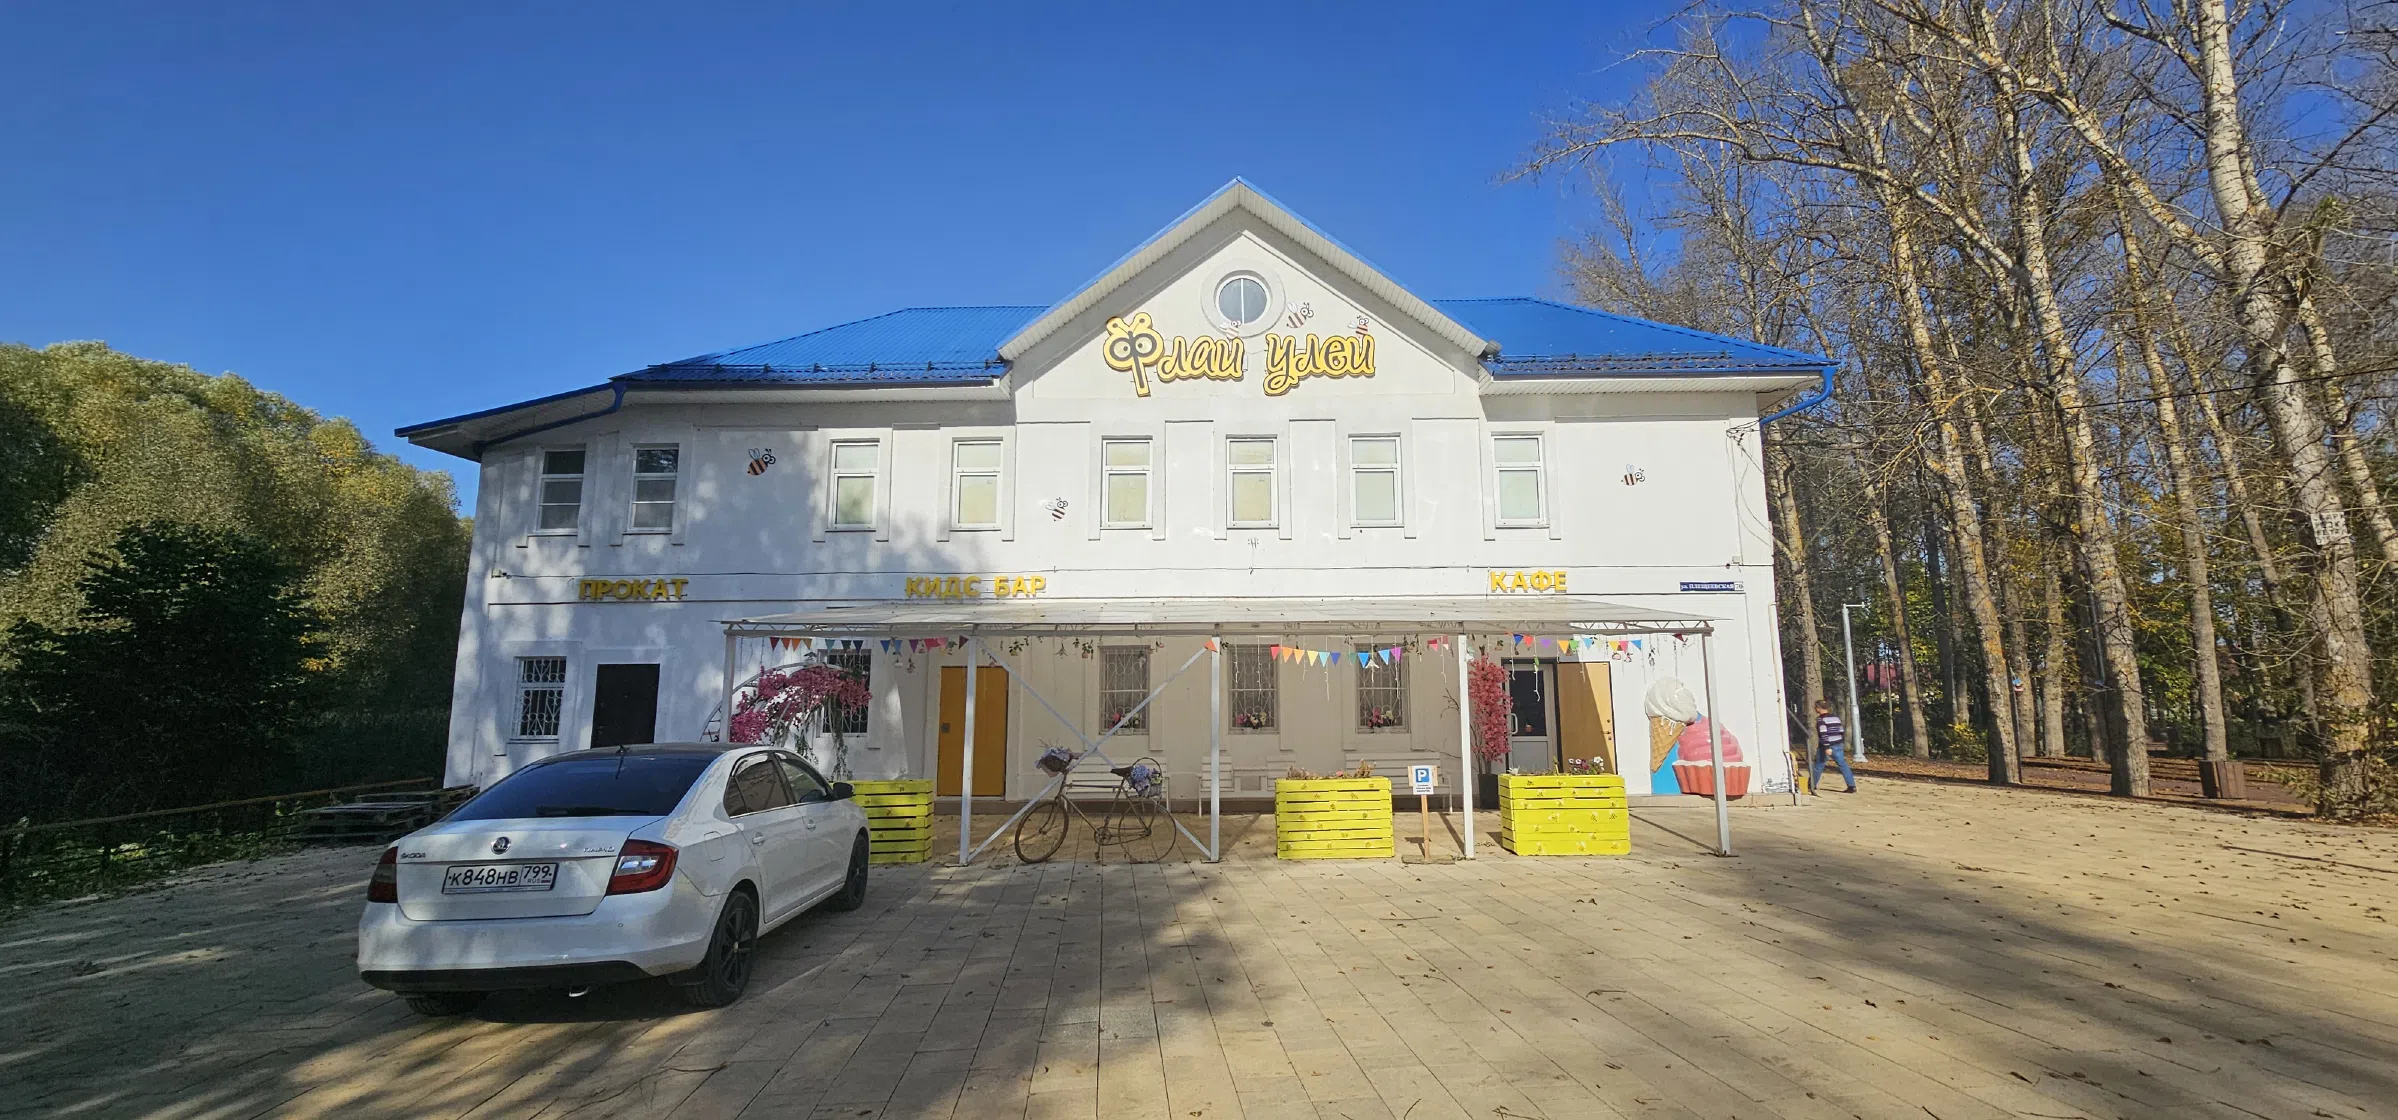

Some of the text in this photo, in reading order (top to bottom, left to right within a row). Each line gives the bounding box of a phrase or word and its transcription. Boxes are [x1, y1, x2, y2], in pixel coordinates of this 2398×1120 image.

[579, 578, 689, 600] ПРОКАТ
[905, 575, 1046, 599] КИДС БАР
[1490, 570, 1568, 593] КАФЕ
